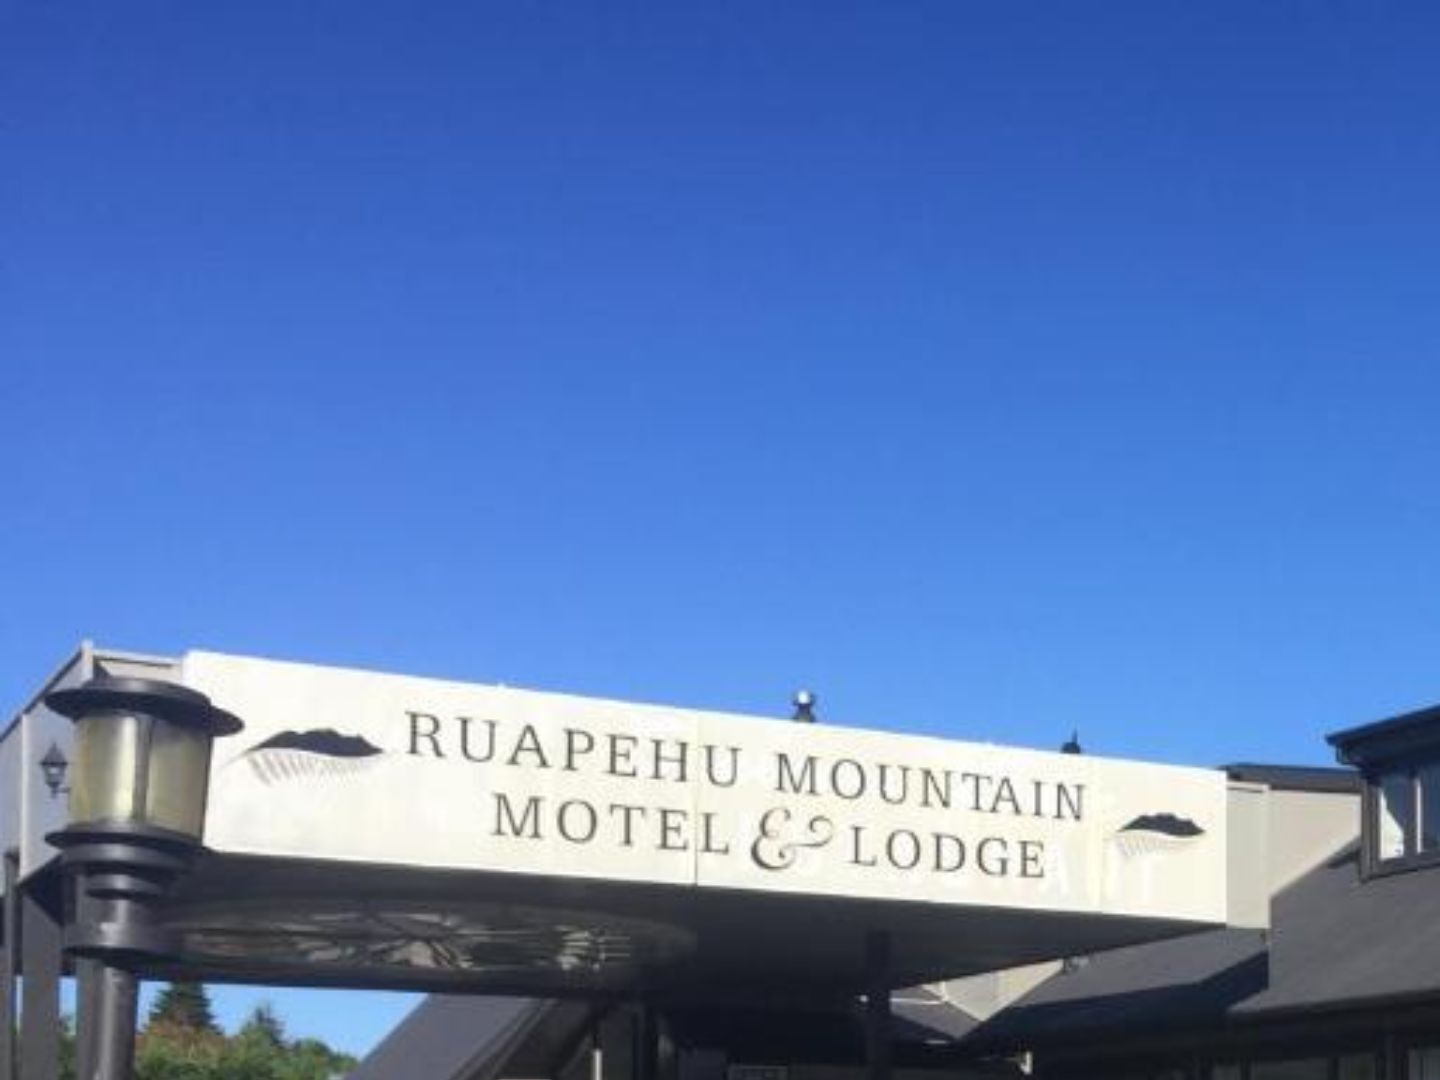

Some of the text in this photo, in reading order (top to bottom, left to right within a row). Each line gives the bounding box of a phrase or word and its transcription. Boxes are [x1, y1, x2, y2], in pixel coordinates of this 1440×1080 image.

[405, 711, 1085, 821] RUAPEHU MOUNTAIN
[491, 792, 1045, 878] MOTEL & LODGE
